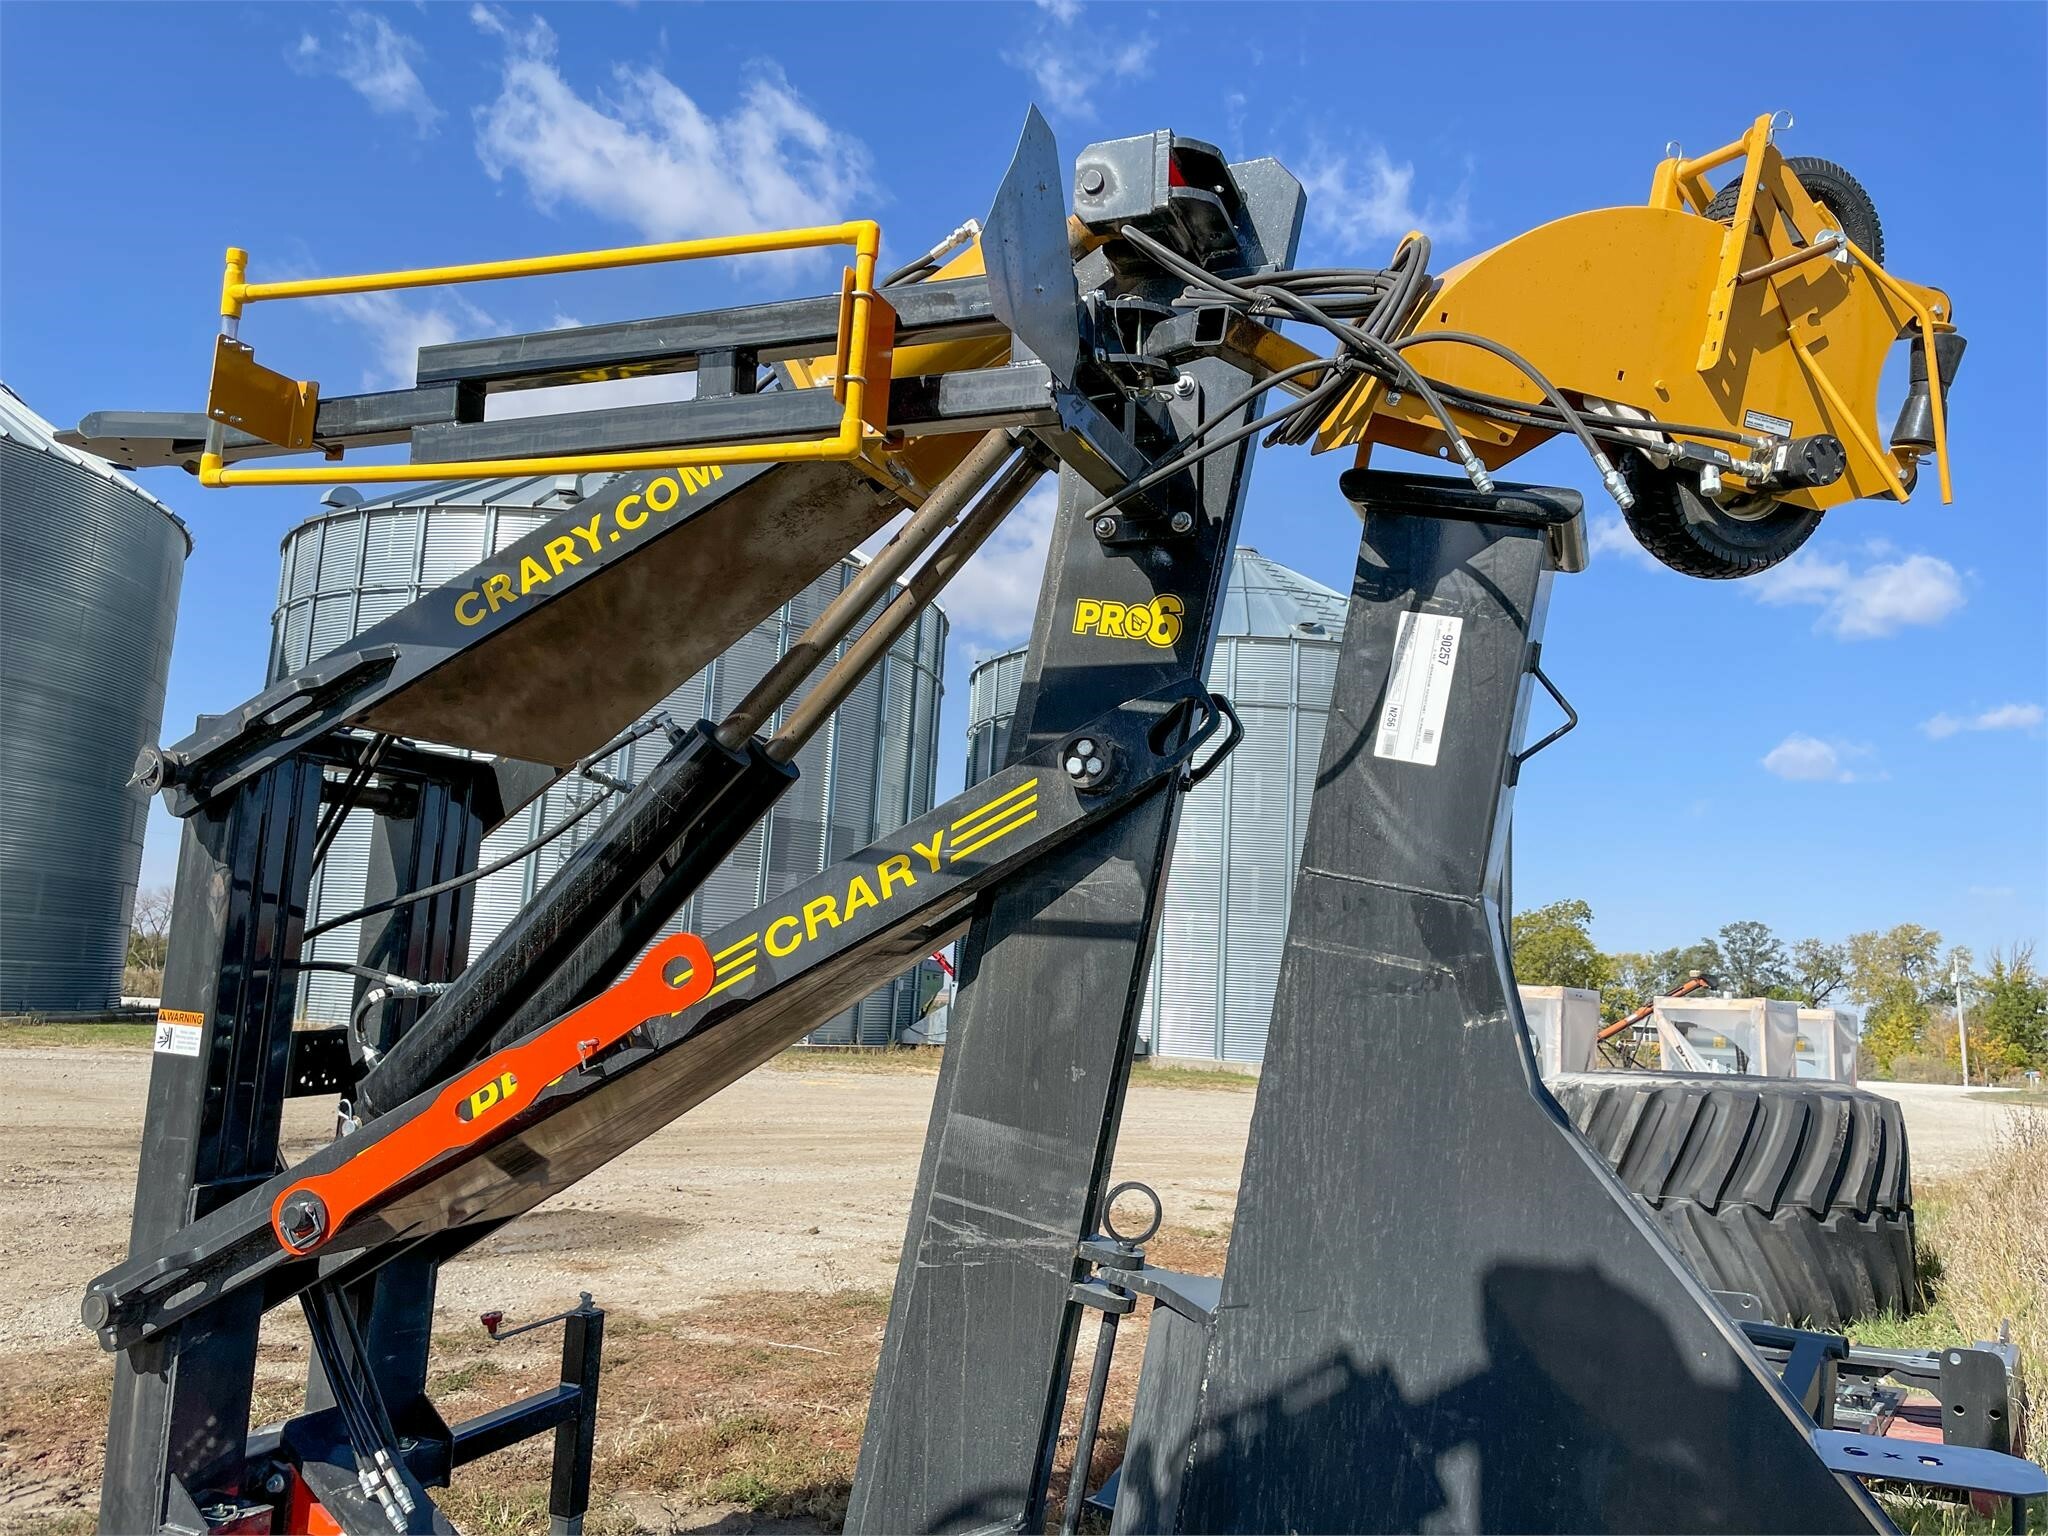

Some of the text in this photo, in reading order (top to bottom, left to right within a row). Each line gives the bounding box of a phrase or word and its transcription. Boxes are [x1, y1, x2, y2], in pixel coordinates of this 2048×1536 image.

[454, 465, 724, 626] CRARY.COM
[1438, 634, 1454, 666] 90257
[1386, 706, 1398, 727] N256
[764, 829, 944, 957] CRARY
[167, 1011, 203, 1025] WARNING
